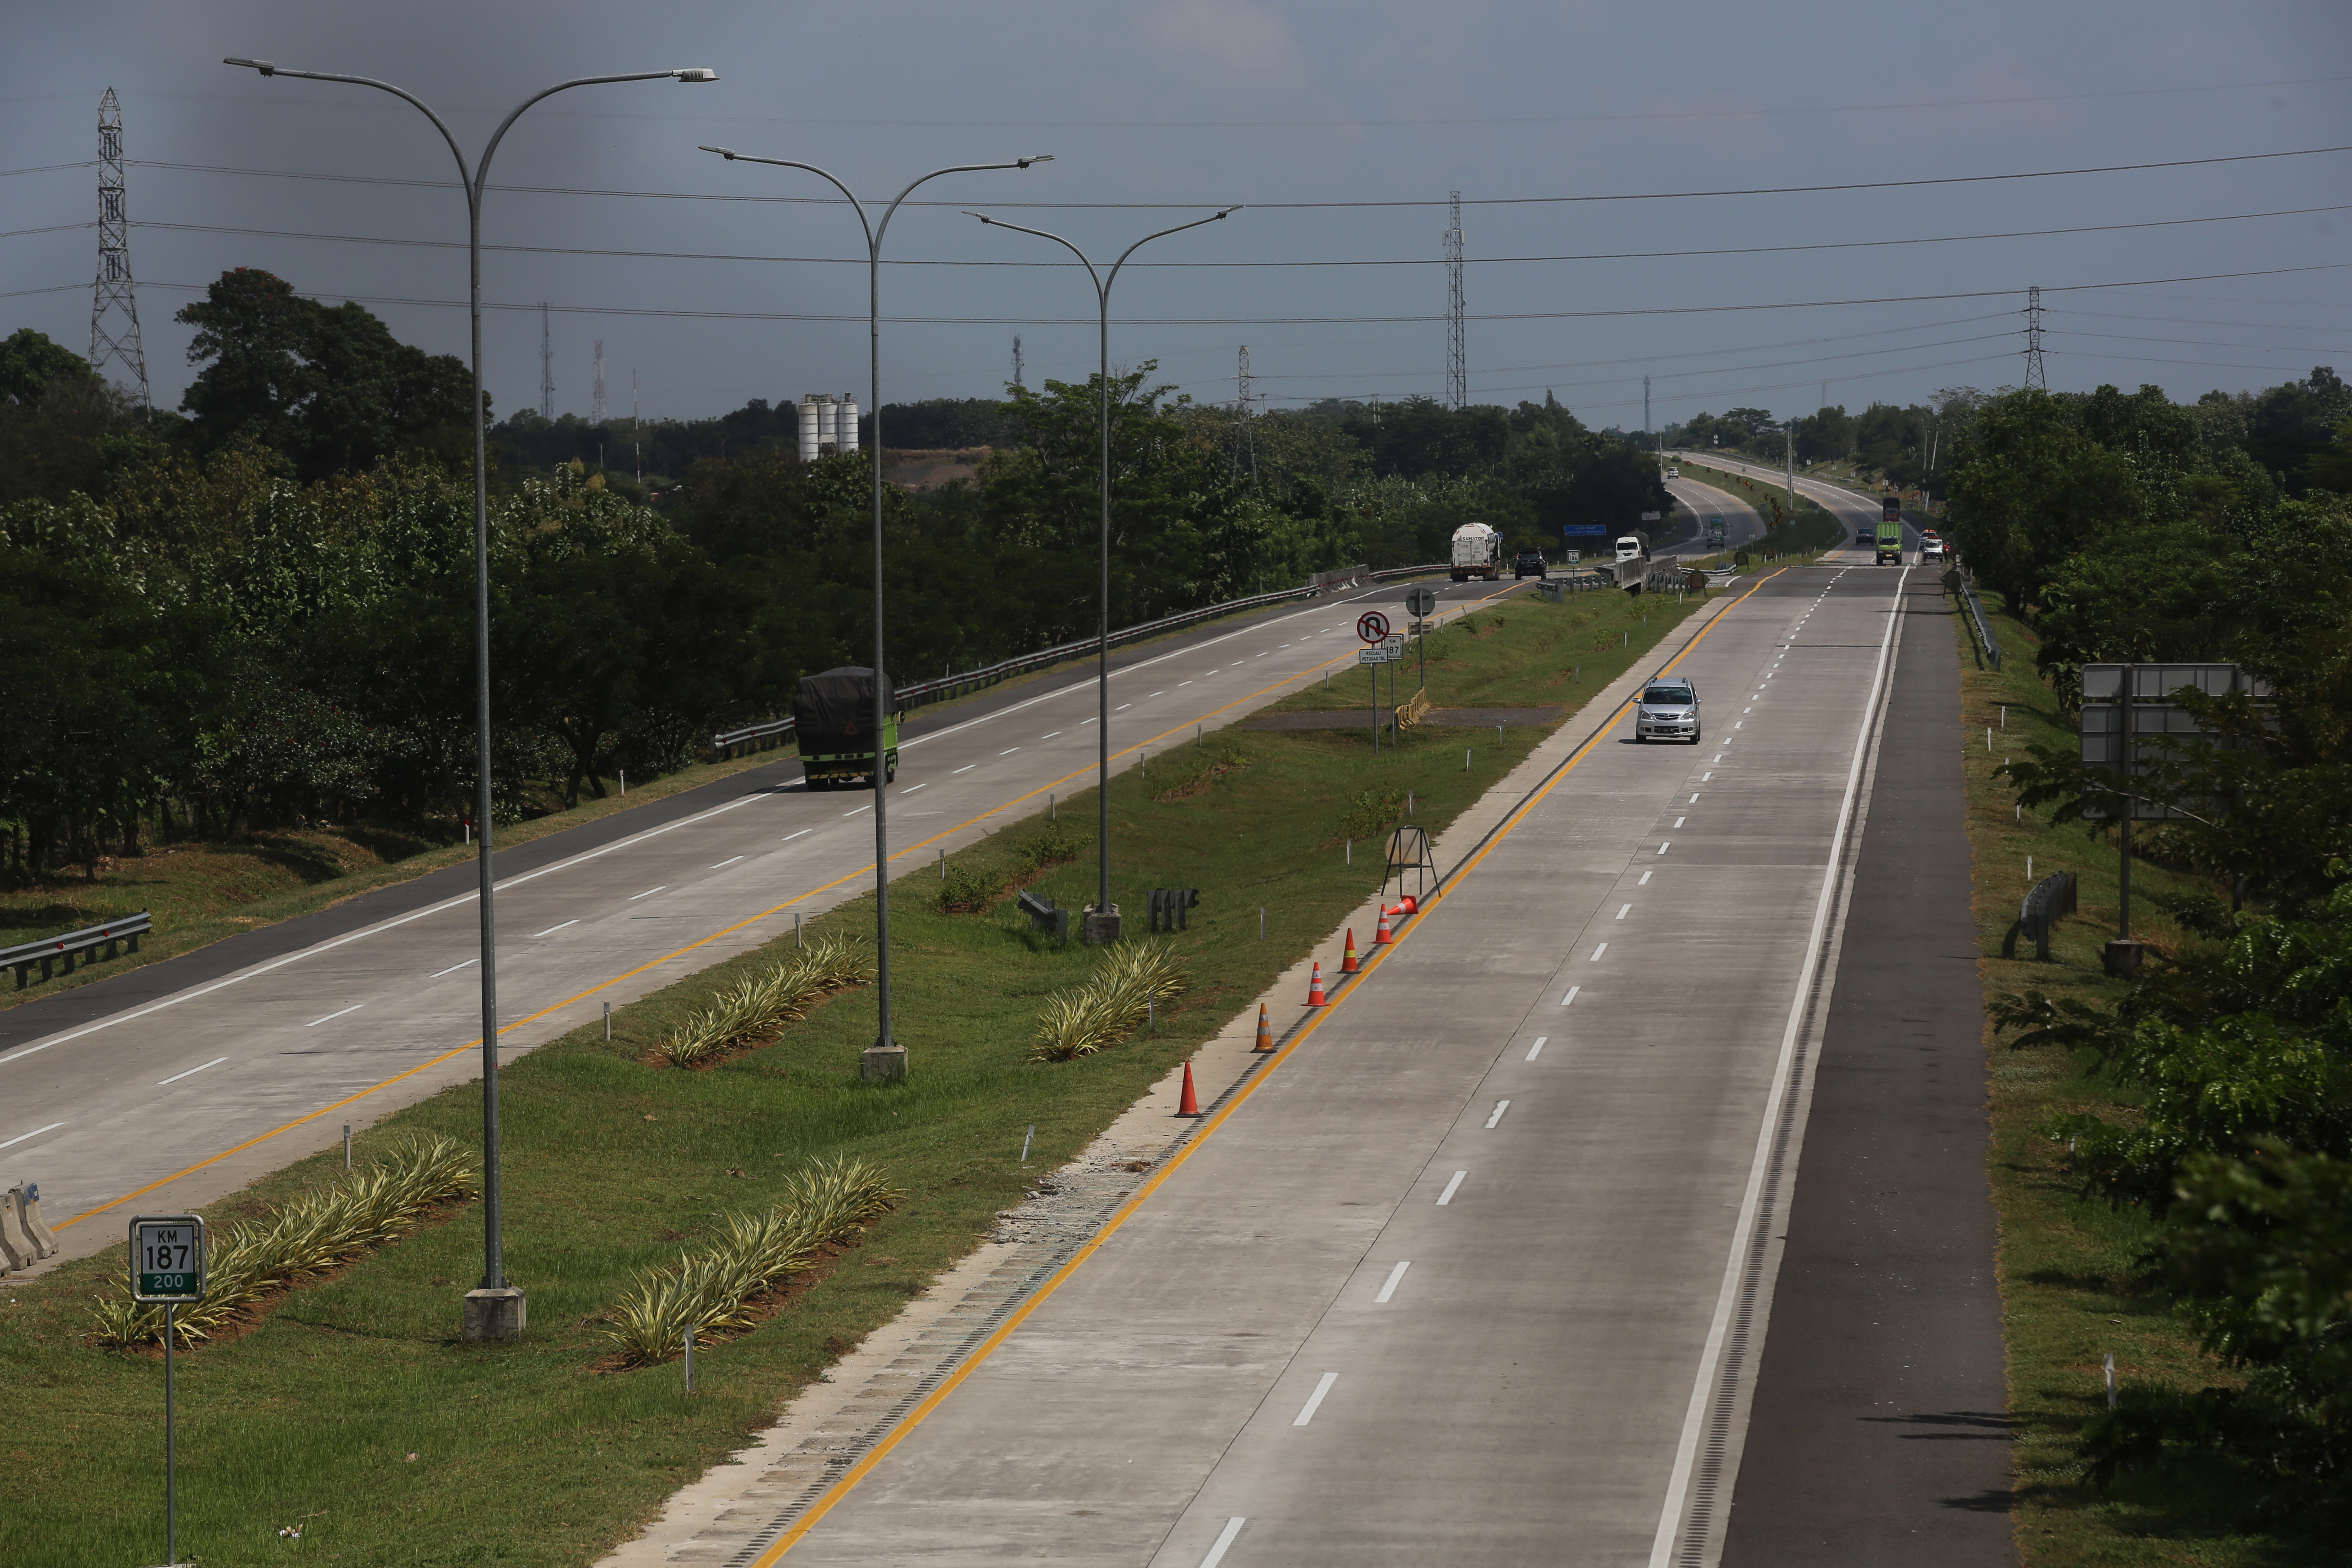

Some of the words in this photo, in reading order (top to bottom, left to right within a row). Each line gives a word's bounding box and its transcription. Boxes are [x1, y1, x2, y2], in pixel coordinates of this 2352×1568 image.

[158, 1230, 177, 1243] KM
[147, 1245, 189, 1270] 187
[154, 1274, 183, 1288] 200
